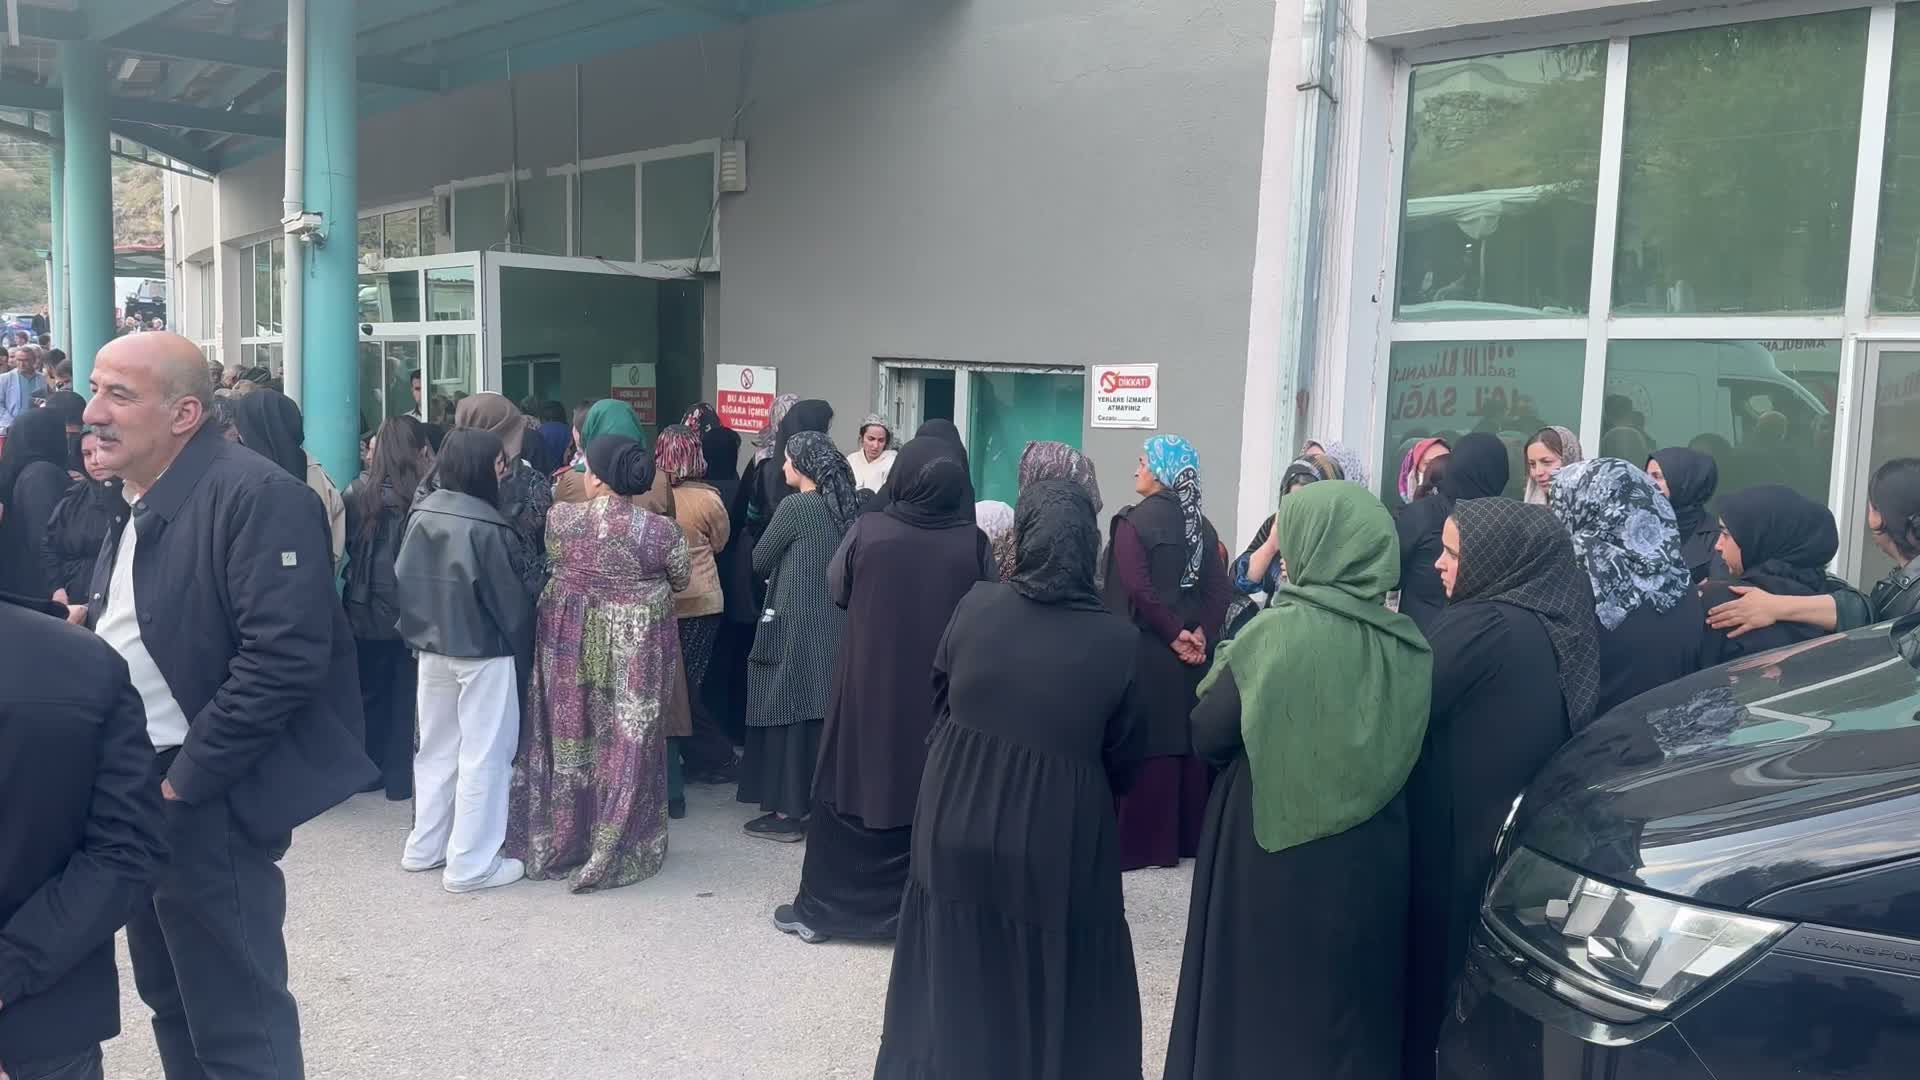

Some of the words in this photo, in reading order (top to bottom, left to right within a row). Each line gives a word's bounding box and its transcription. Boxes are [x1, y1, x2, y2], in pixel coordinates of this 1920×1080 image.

[727, 394, 737, 403] BU
[738, 394, 765, 405] ALANDA
[721, 405, 747, 415] SİGARA
[730, 418, 763, 428] YASAKTIR
